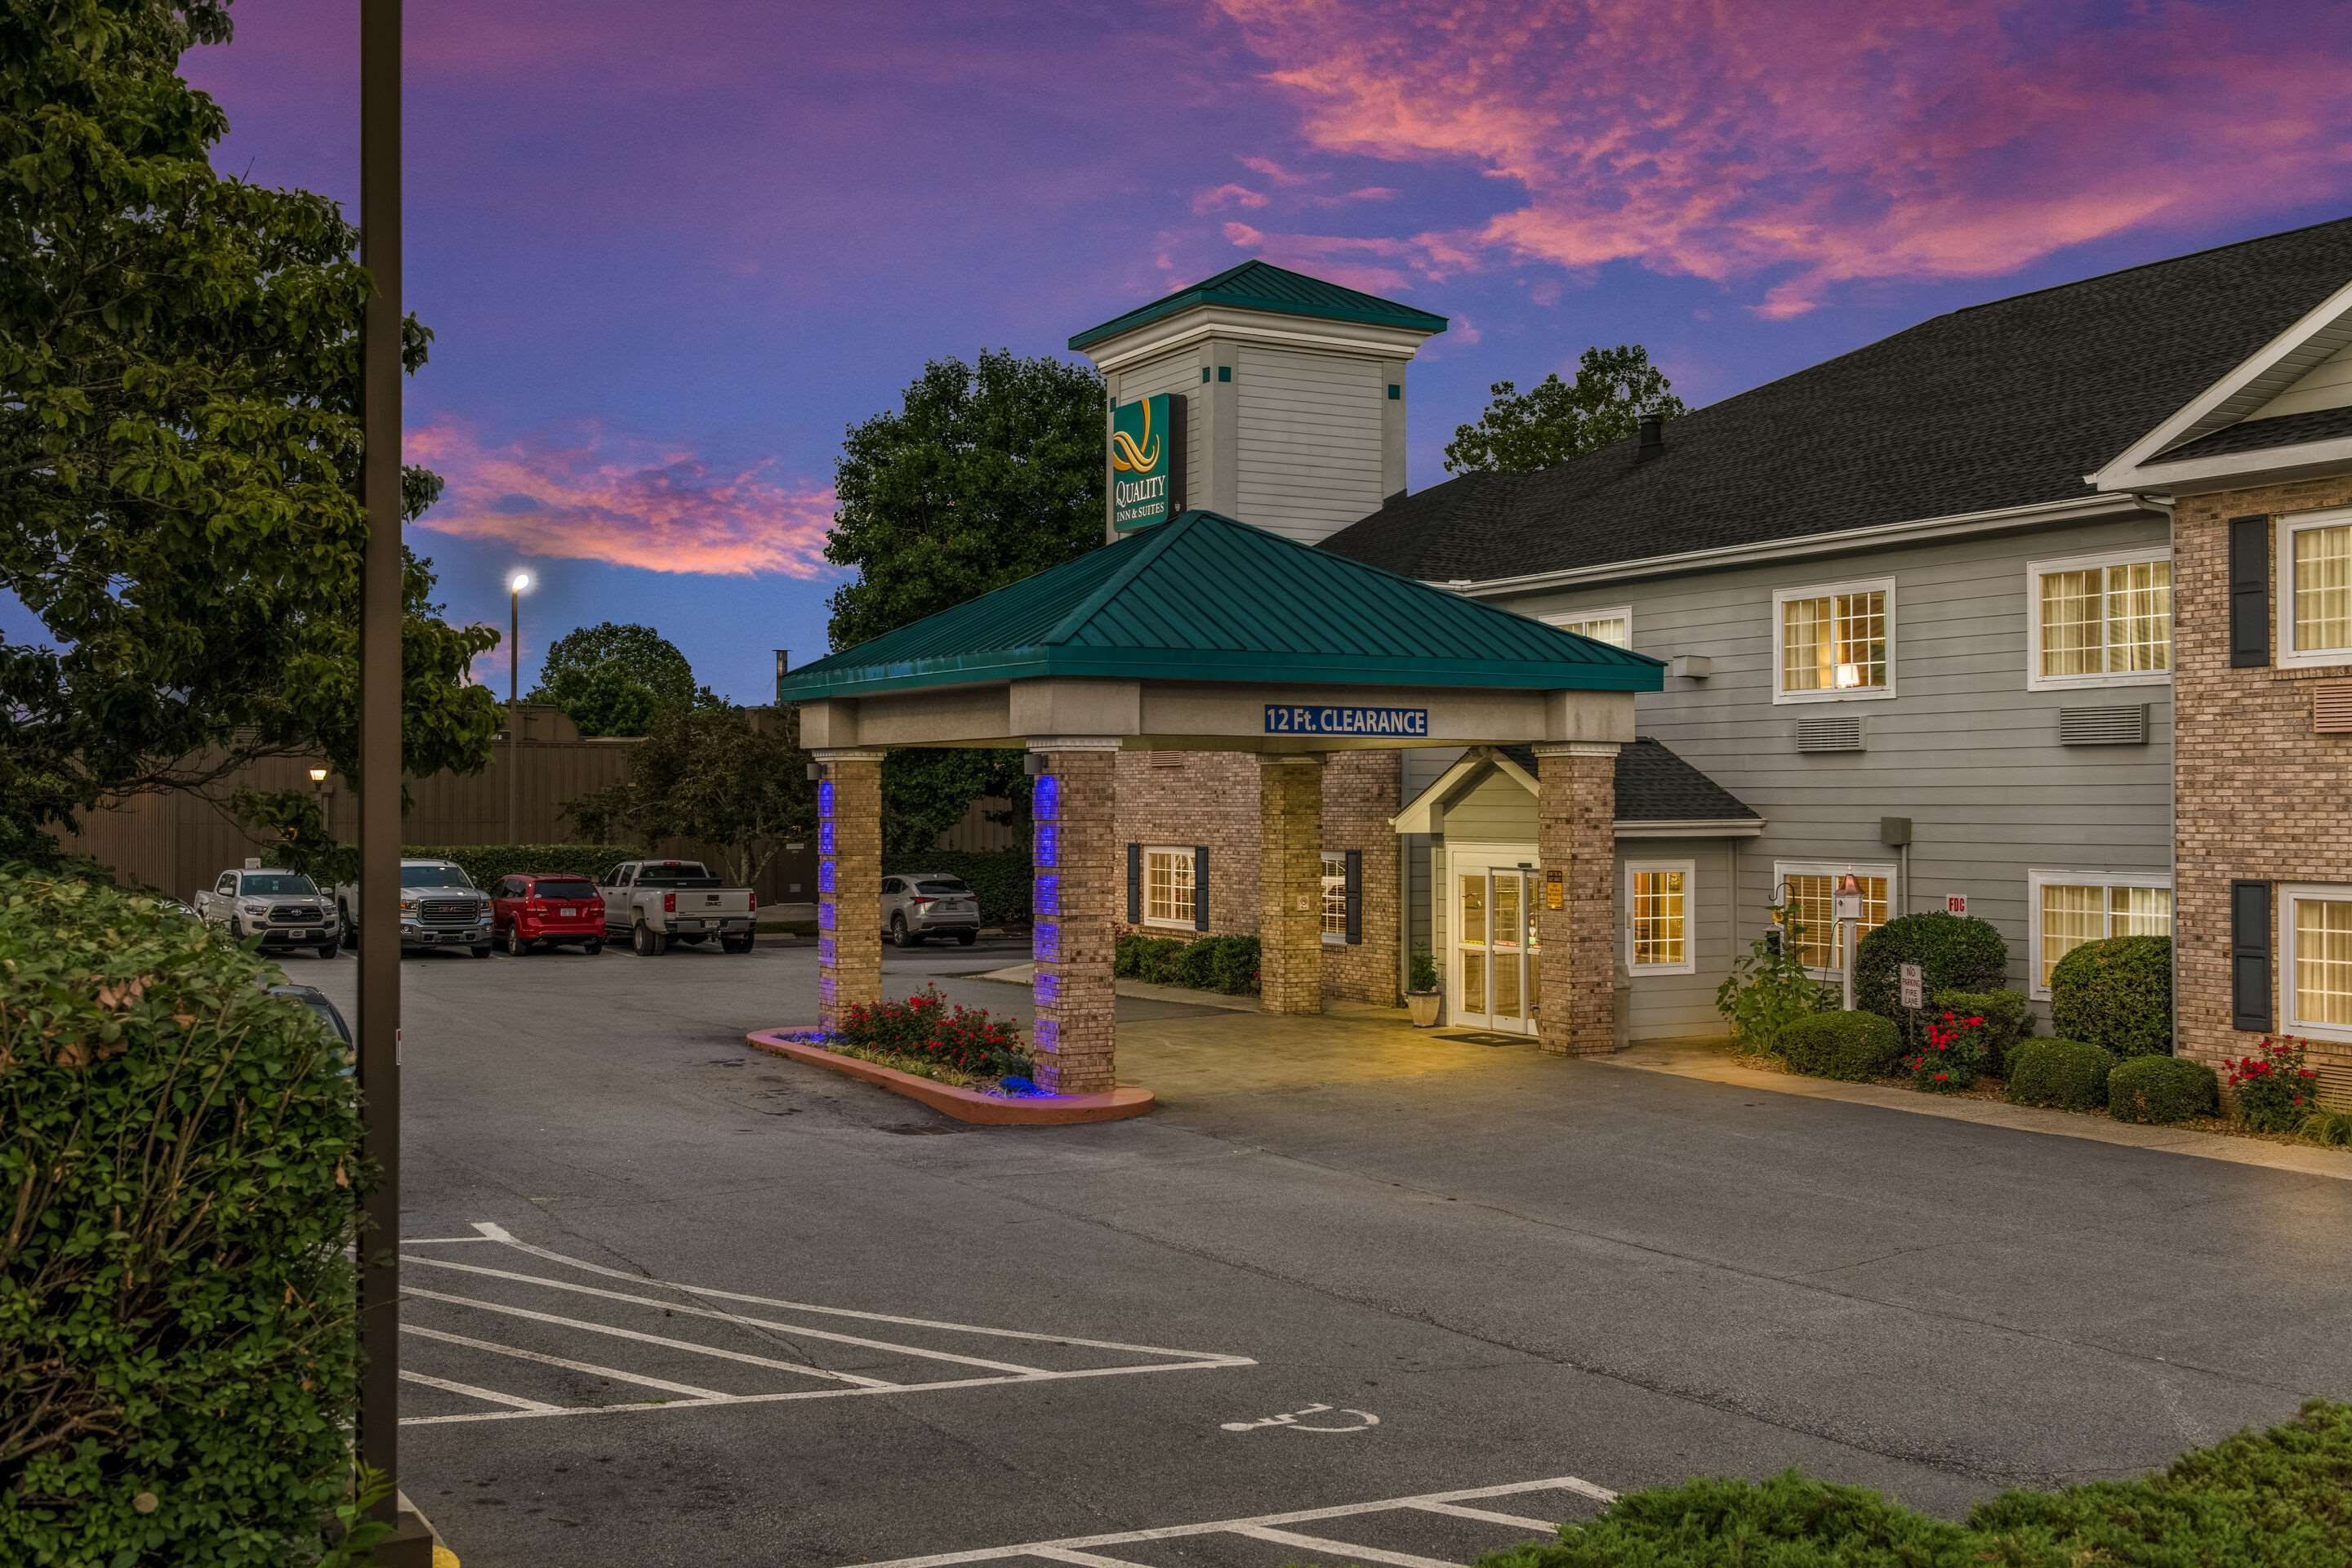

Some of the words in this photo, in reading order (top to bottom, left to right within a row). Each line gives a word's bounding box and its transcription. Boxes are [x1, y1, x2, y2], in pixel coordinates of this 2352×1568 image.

[1116, 475, 1165, 507] QUALITY
[1116, 510, 1131, 522] INN
[1132, 508, 1138, 519] &
[1138, 502, 1165, 517] SUITES
[1267, 709, 1289, 730] 12
[1294, 709, 1316, 731] Ft.
[1321, 709, 1425, 733] CLEARANCE
[1949, 898, 1965, 911] FDC
[1906, 966, 1915, 977] NO
[1902, 978, 1920, 987] PARKING
[1904, 989, 1918, 997] FIRE
[1904, 997, 1918, 1005] LANE
